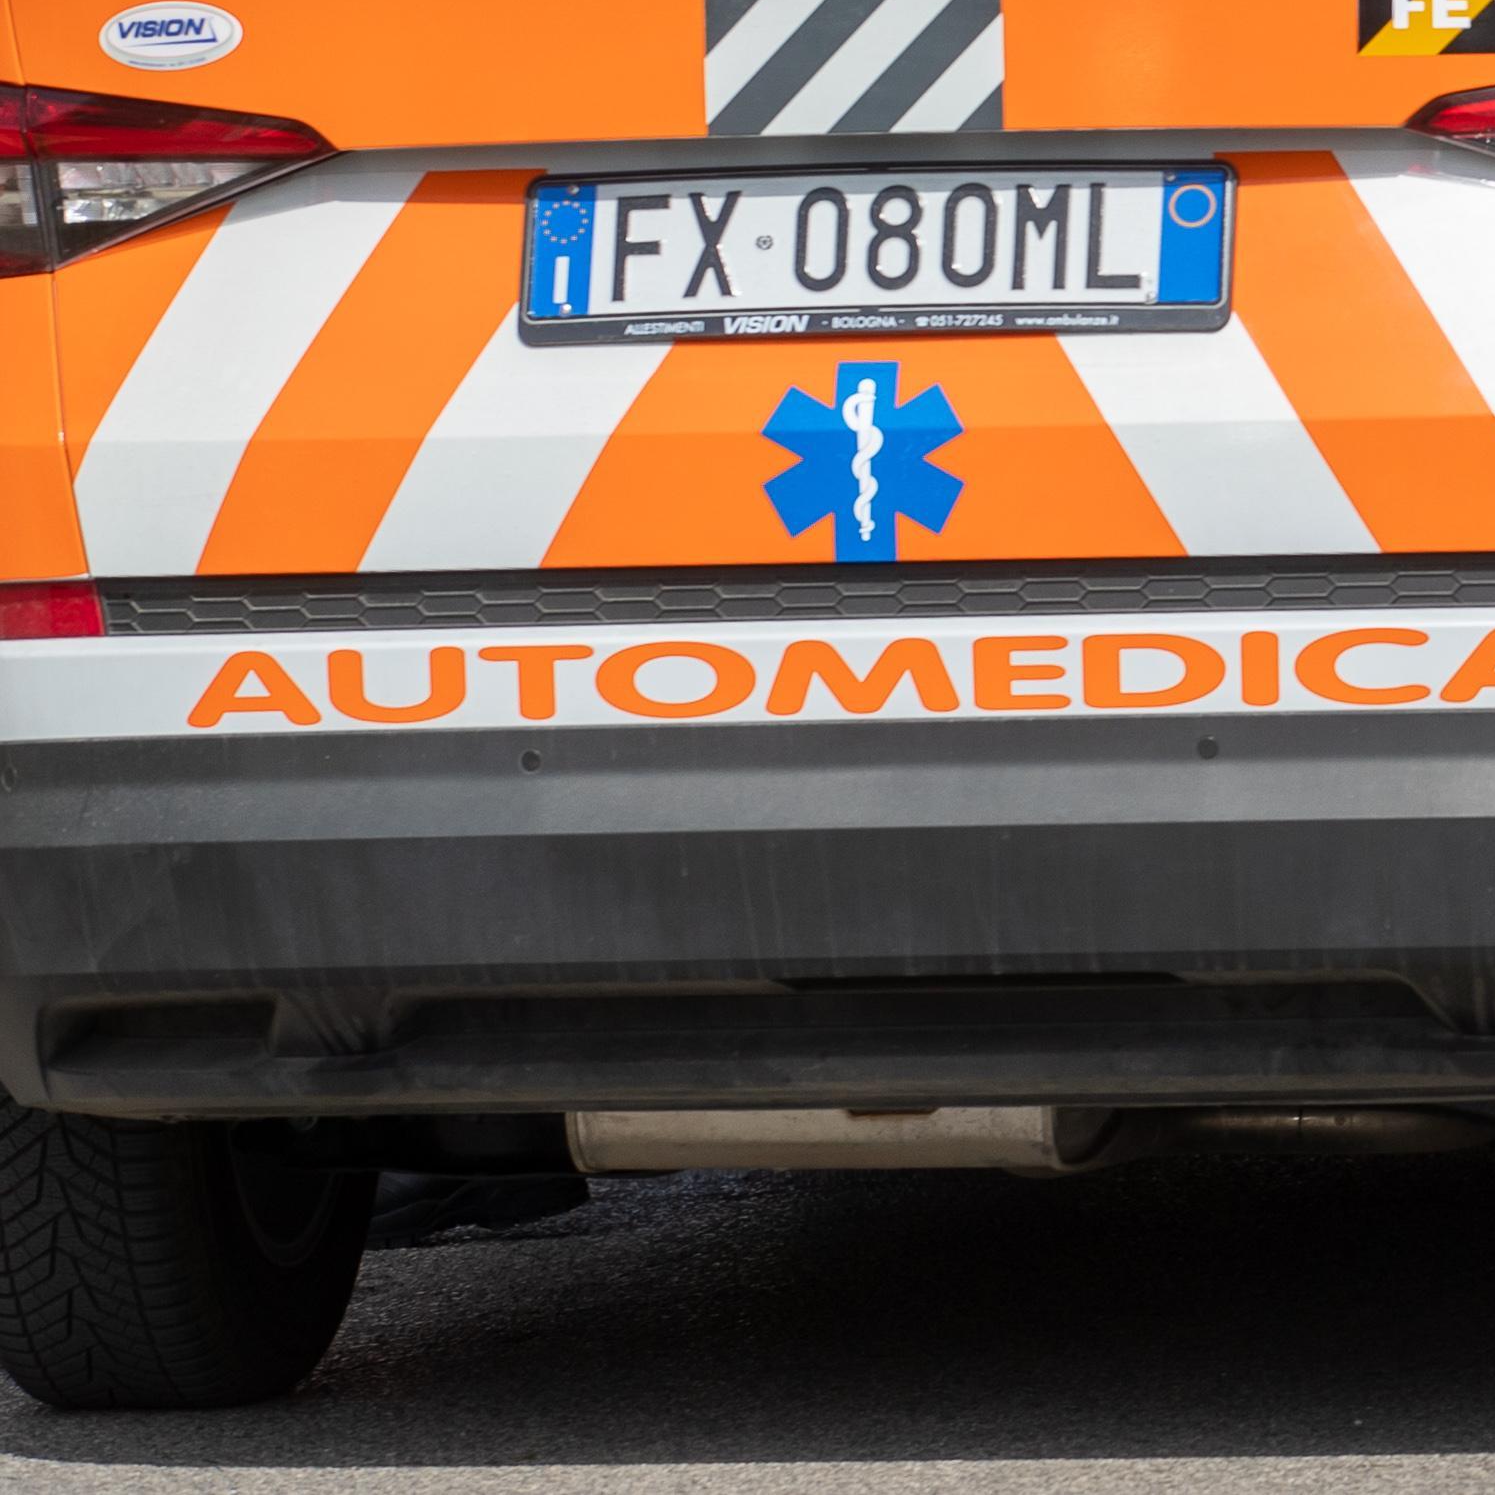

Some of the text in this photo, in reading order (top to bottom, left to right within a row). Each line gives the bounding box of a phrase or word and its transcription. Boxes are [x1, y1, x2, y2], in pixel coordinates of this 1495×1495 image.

[118, 18, 206, 39] VISION
[612, 190, 742, 302] FX
[795, 182, 1143, 293] 080ML
[723, 315, 810, 334] VISION
[832, 316, 897, 329] BOLOGNA
